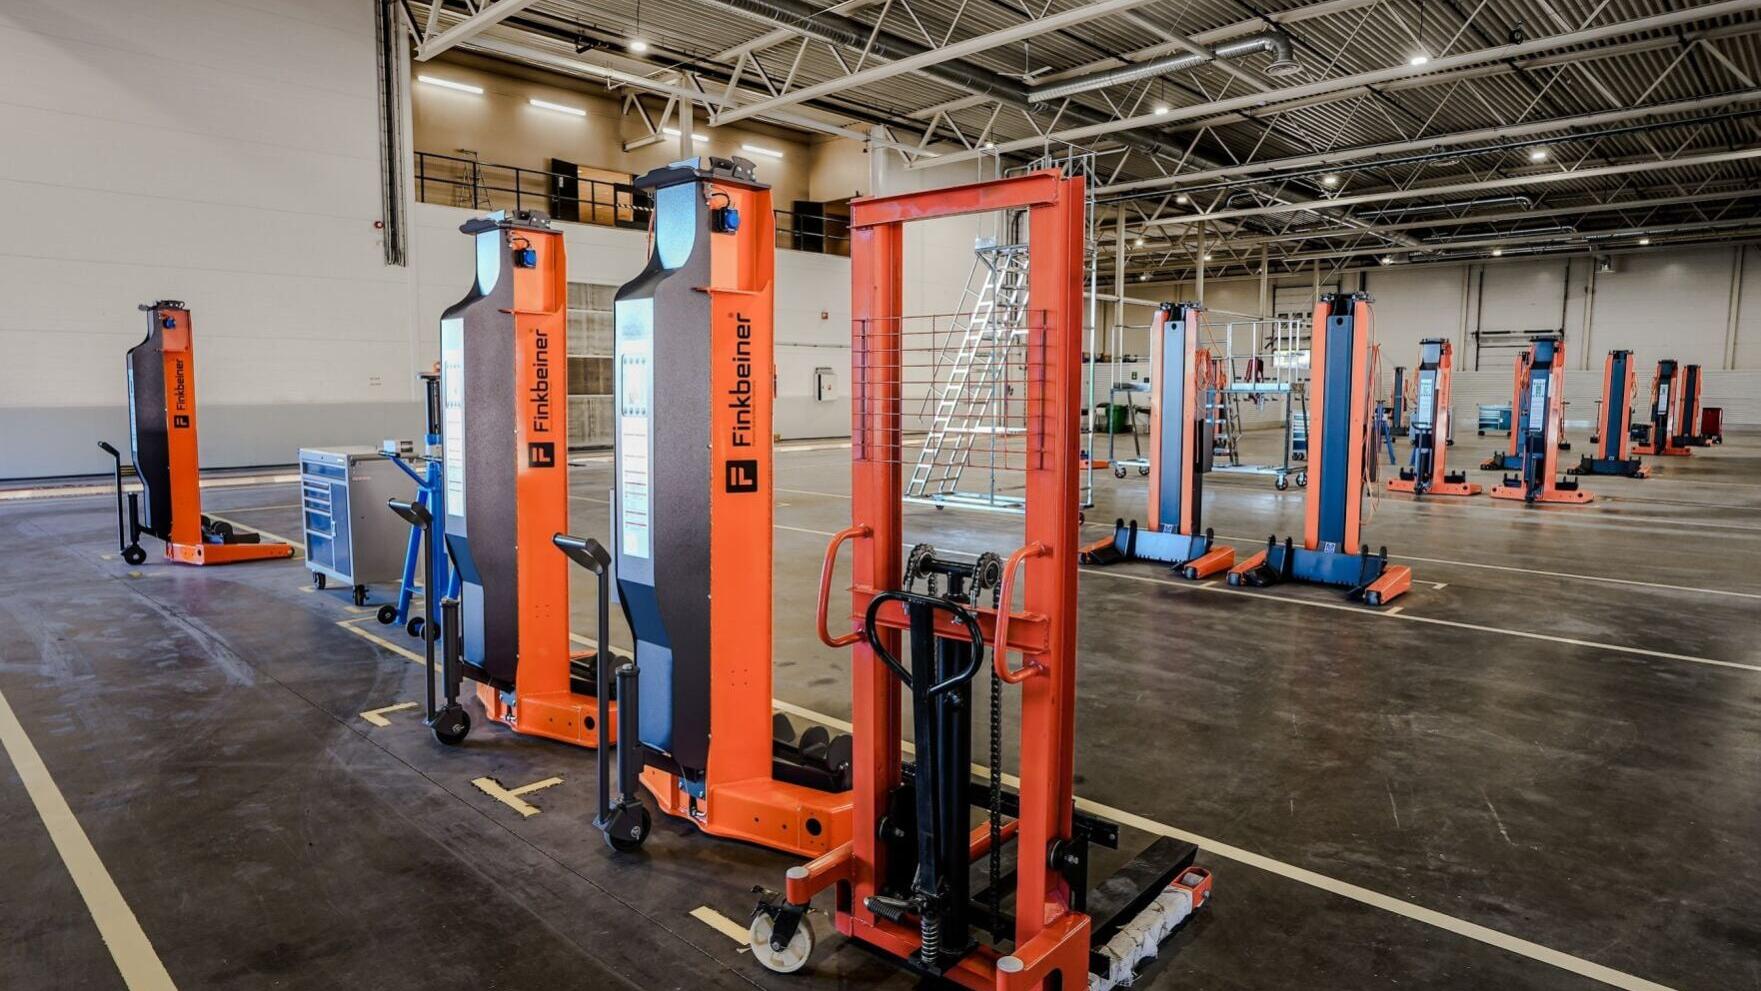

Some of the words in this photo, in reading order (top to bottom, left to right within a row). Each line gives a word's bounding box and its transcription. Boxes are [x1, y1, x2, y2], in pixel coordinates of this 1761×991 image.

[174, 359, 185, 411] Finkbeiner
[530, 329, 549, 433] Finkbeiner
[728, 312, 751, 447] Finkbeiner
